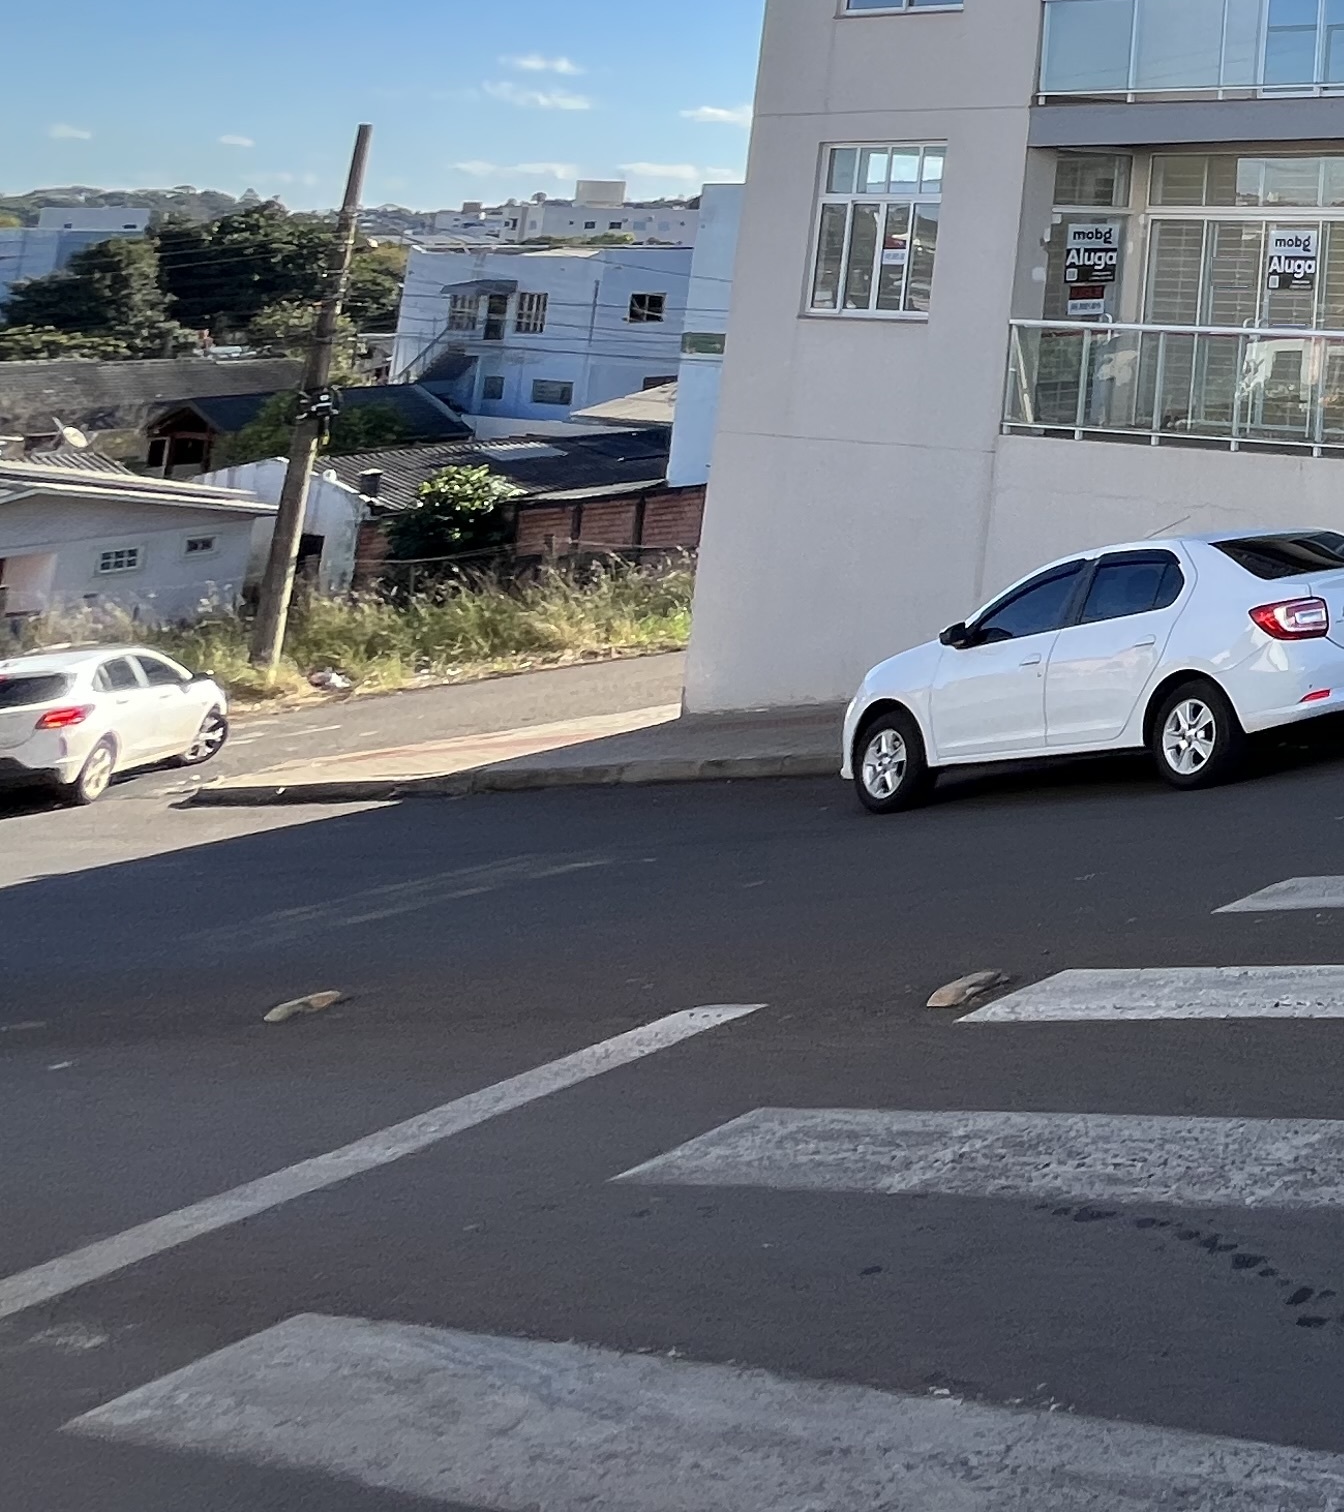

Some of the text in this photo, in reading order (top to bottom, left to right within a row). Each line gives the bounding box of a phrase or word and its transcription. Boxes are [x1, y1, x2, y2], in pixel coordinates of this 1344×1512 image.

[1073, 228, 1112, 244] mobg
[1275, 235, 1311, 252] mobg
[1066, 248, 1117, 270] Aluga
[1269, 256, 1316, 278] Aluga
